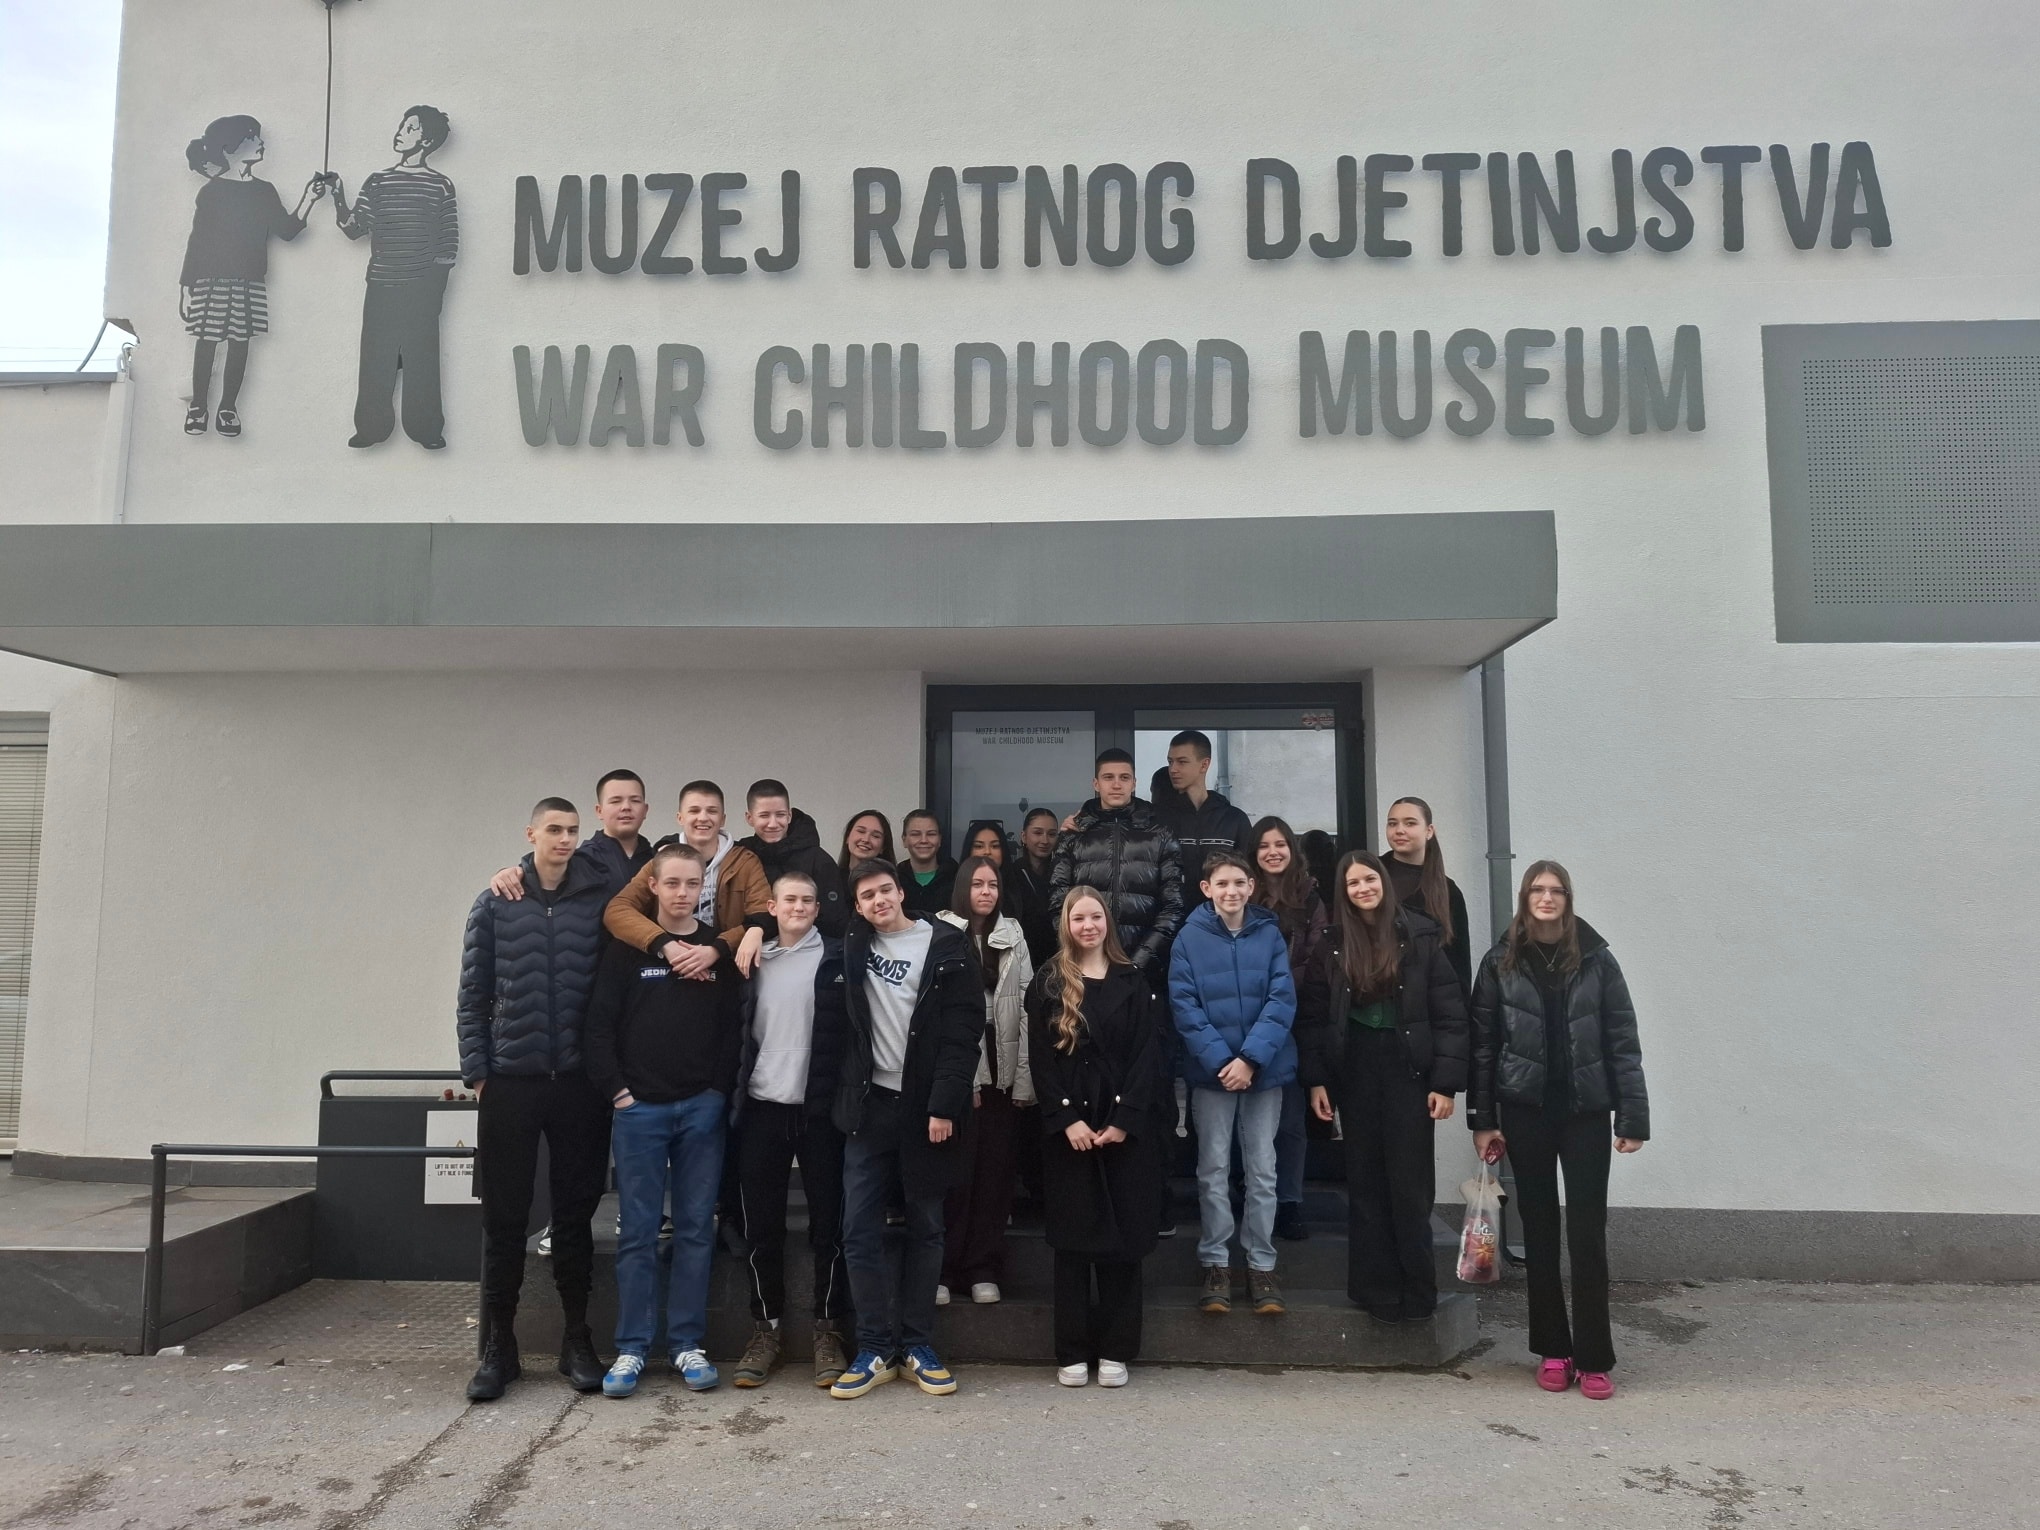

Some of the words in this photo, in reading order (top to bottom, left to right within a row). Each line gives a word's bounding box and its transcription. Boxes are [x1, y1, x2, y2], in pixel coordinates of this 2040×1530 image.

[513, 169, 801, 275] MUZEJ
[853, 161, 1196, 270] RATNOG
[1246, 141, 1893, 261] DJETINJSTVA
[512, 343, 706, 447] WAR
[753, 338, 1250, 449] CHILDHOOD
[1299, 324, 1707, 438] MUSEUM
[975, 727, 997, 735] MUZEJ
[1000, 727, 1025, 735] RATNOG
[1027, 726, 1071, 735] DJETINJSTVA
[982, 736, 997, 745] WAR
[999, 736, 1034, 745] CHILDHOOD
[1036, 736, 1064, 744] MUSEUM
